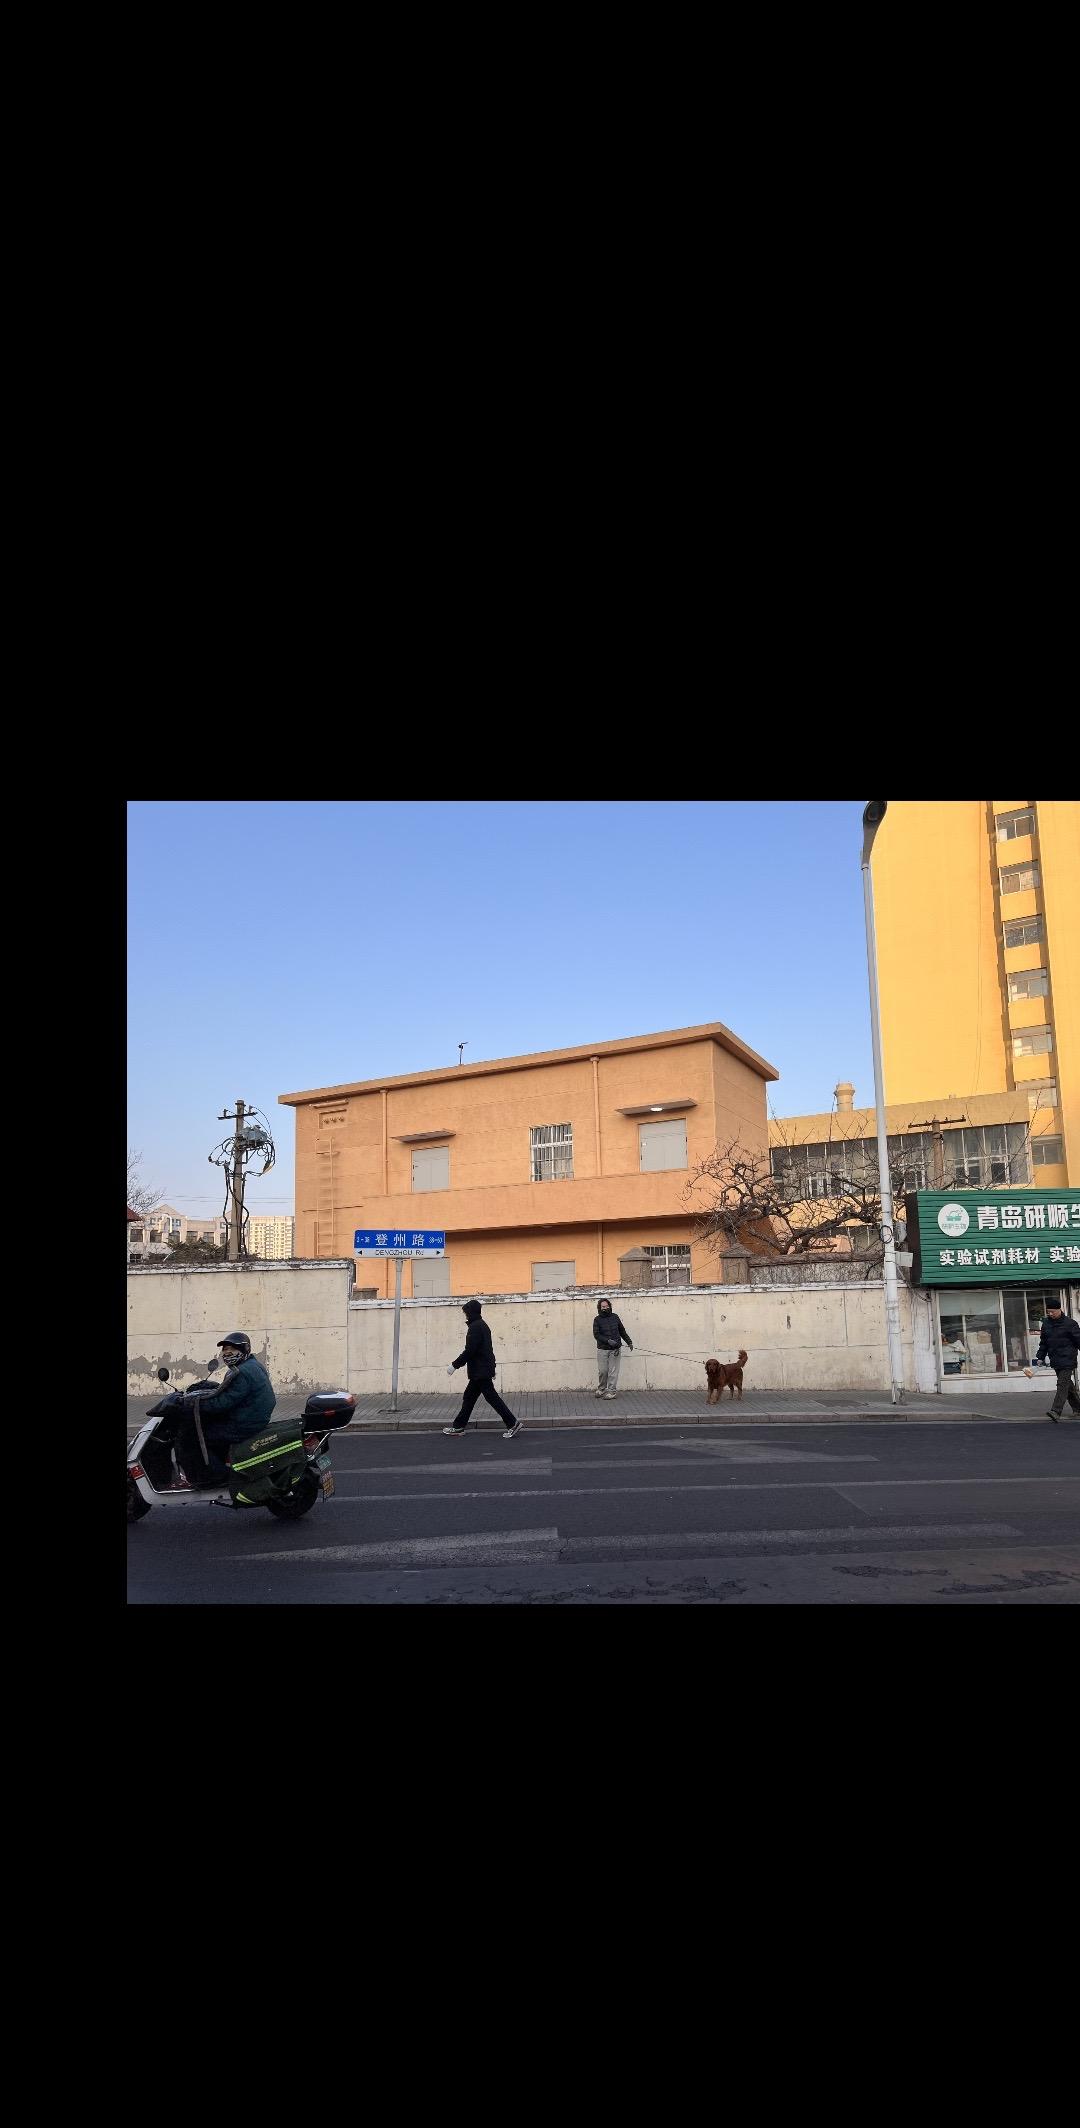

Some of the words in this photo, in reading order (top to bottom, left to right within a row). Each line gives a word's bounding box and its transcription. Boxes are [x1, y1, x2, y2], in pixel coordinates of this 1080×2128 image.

[375, 1233, 425, 1246] 登州路
[939, 1248, 1040, 1266] 实验试剂耗材
[1049, 1245, 1080, 1263] 实验
